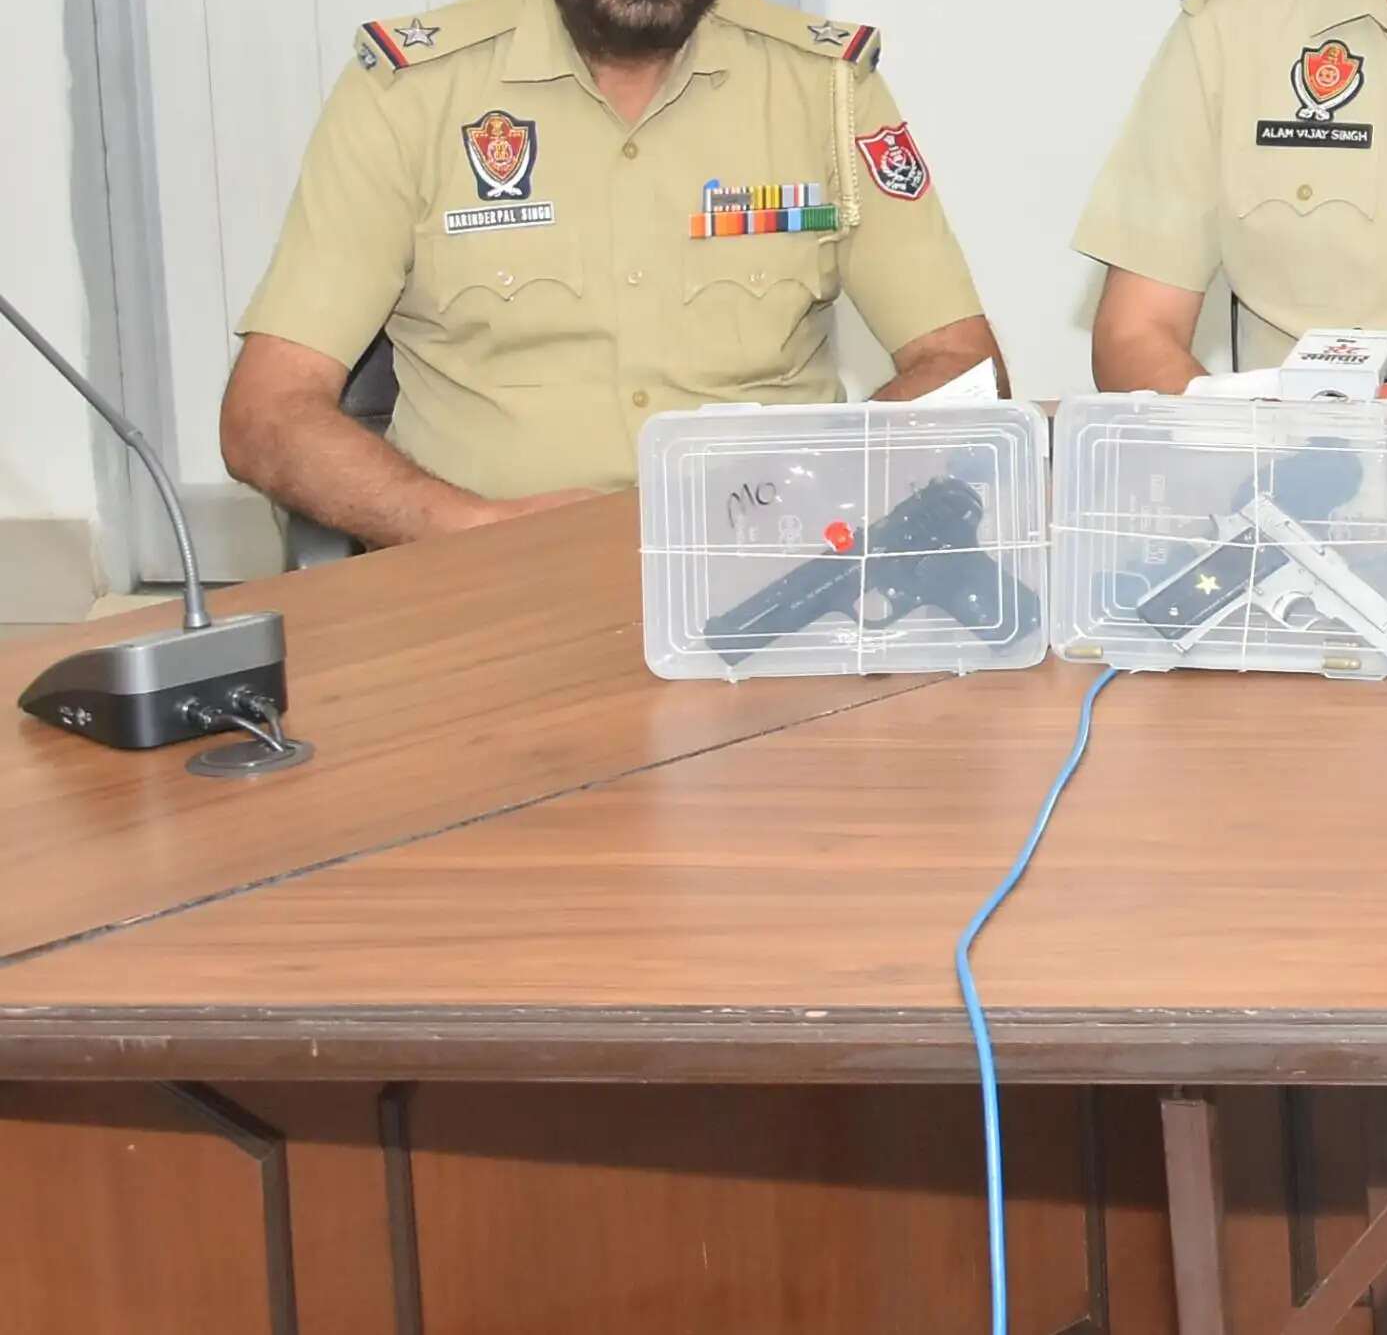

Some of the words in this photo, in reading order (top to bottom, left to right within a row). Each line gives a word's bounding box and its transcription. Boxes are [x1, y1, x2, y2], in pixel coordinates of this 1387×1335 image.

[1262, 128, 1294, 138] ALAM
[1296, 130, 1329, 139] VIJAY
[1330, 130, 1368, 141] SINGH
